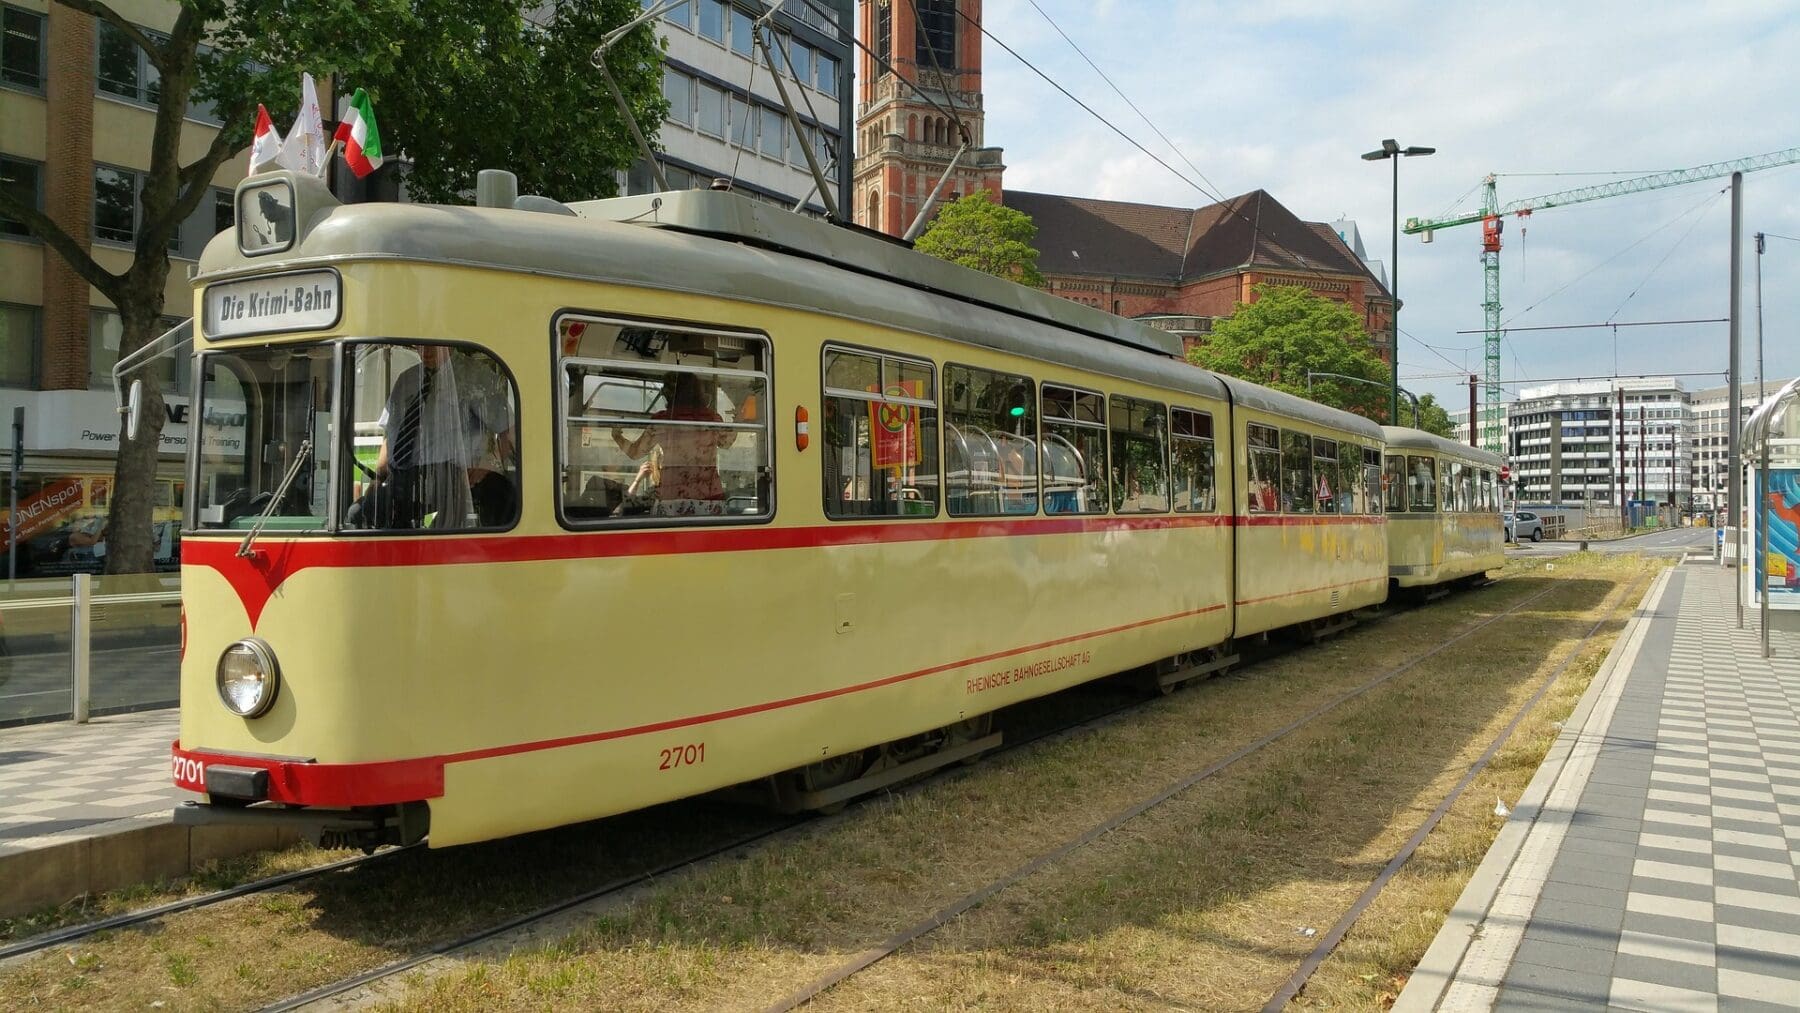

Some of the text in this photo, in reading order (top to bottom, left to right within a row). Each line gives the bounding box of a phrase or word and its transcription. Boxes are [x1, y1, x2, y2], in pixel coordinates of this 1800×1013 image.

[221, 285, 332, 321] Die Krimi-Bahn
[81, 429, 116, 442] Power
[966, 651, 1091, 694] RHEINISCHE BAHNGESELLSCHAFT AG
[173, 755, 204, 785] 2701
[659, 742, 705, 770] 2701
